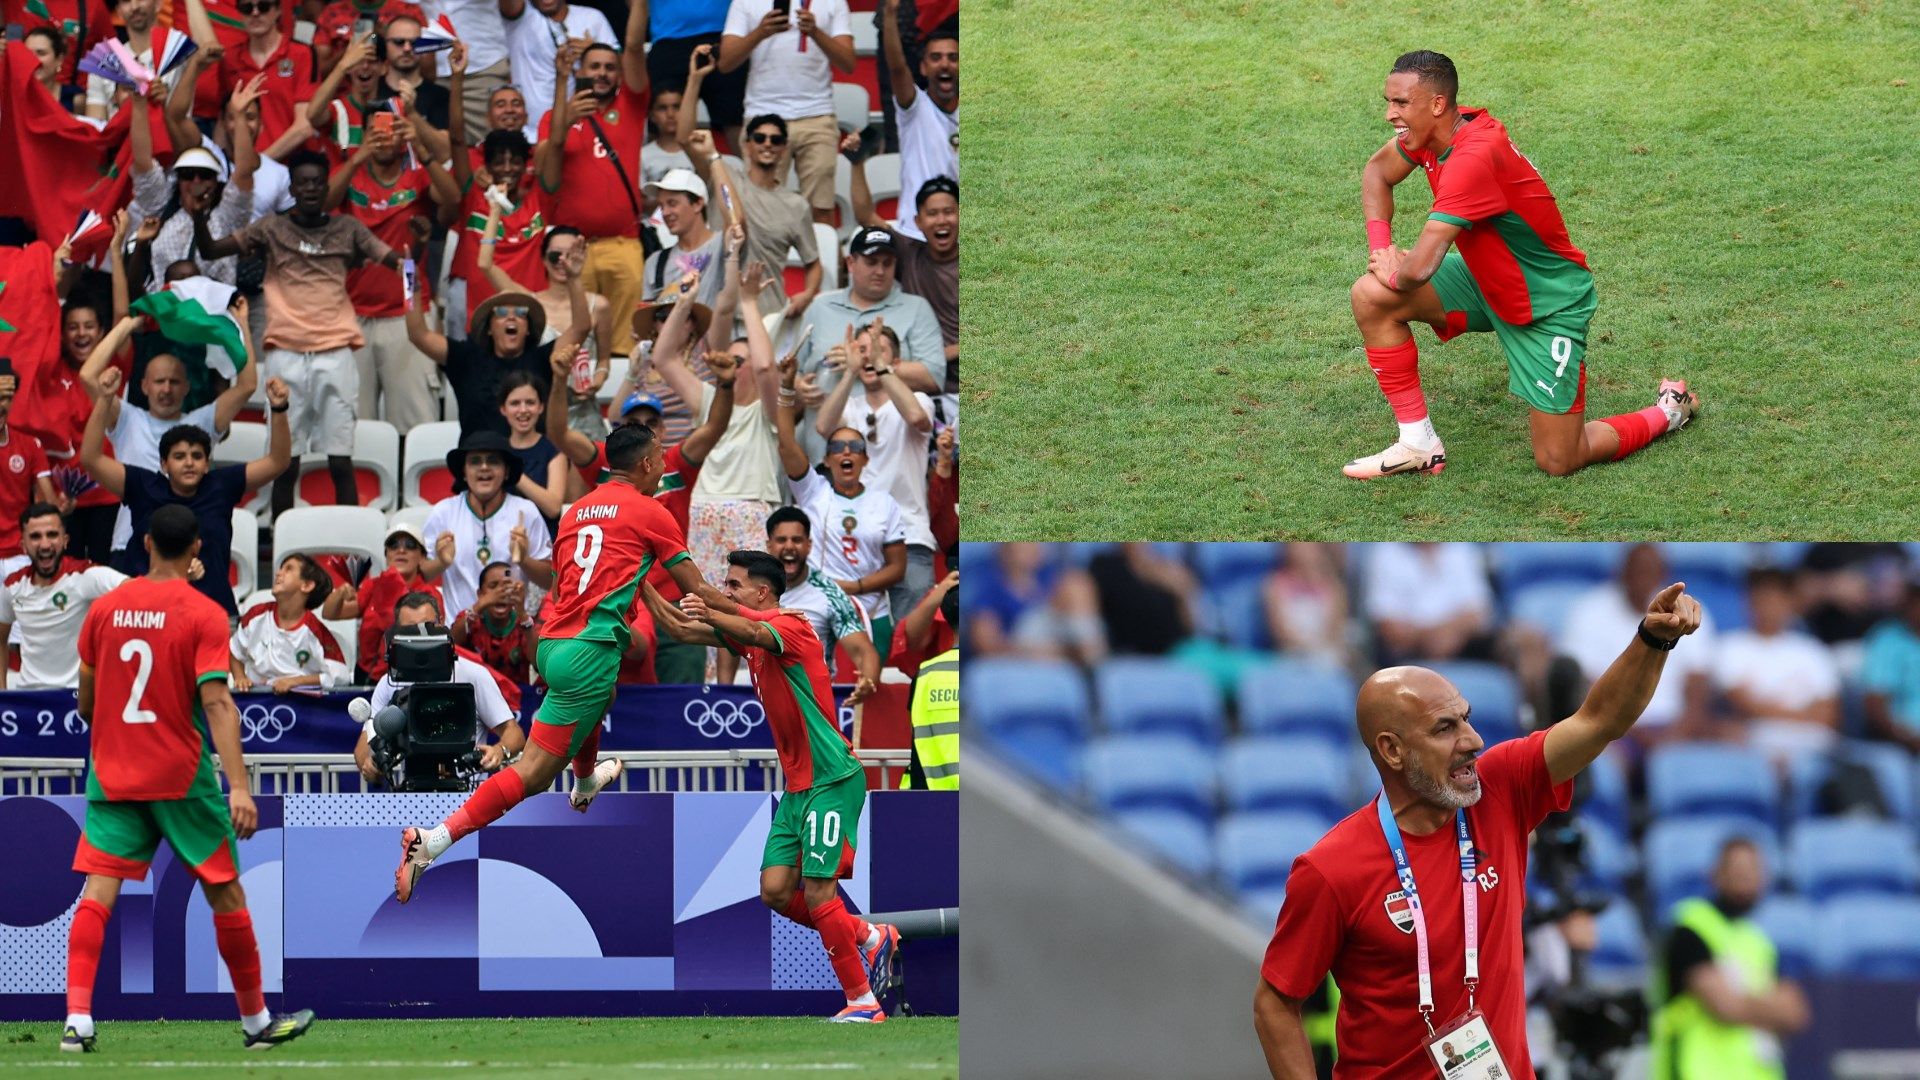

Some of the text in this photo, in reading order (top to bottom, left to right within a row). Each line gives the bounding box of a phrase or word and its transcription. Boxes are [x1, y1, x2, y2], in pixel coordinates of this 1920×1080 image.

[1551, 336, 1572, 378] 9
[573, 524, 604, 596] 9
[112, 609, 166, 629] HAKIMI
[119, 638, 158, 724] 2
[806, 810, 841, 848] 10
[1389, 892, 1407, 900] IRA
